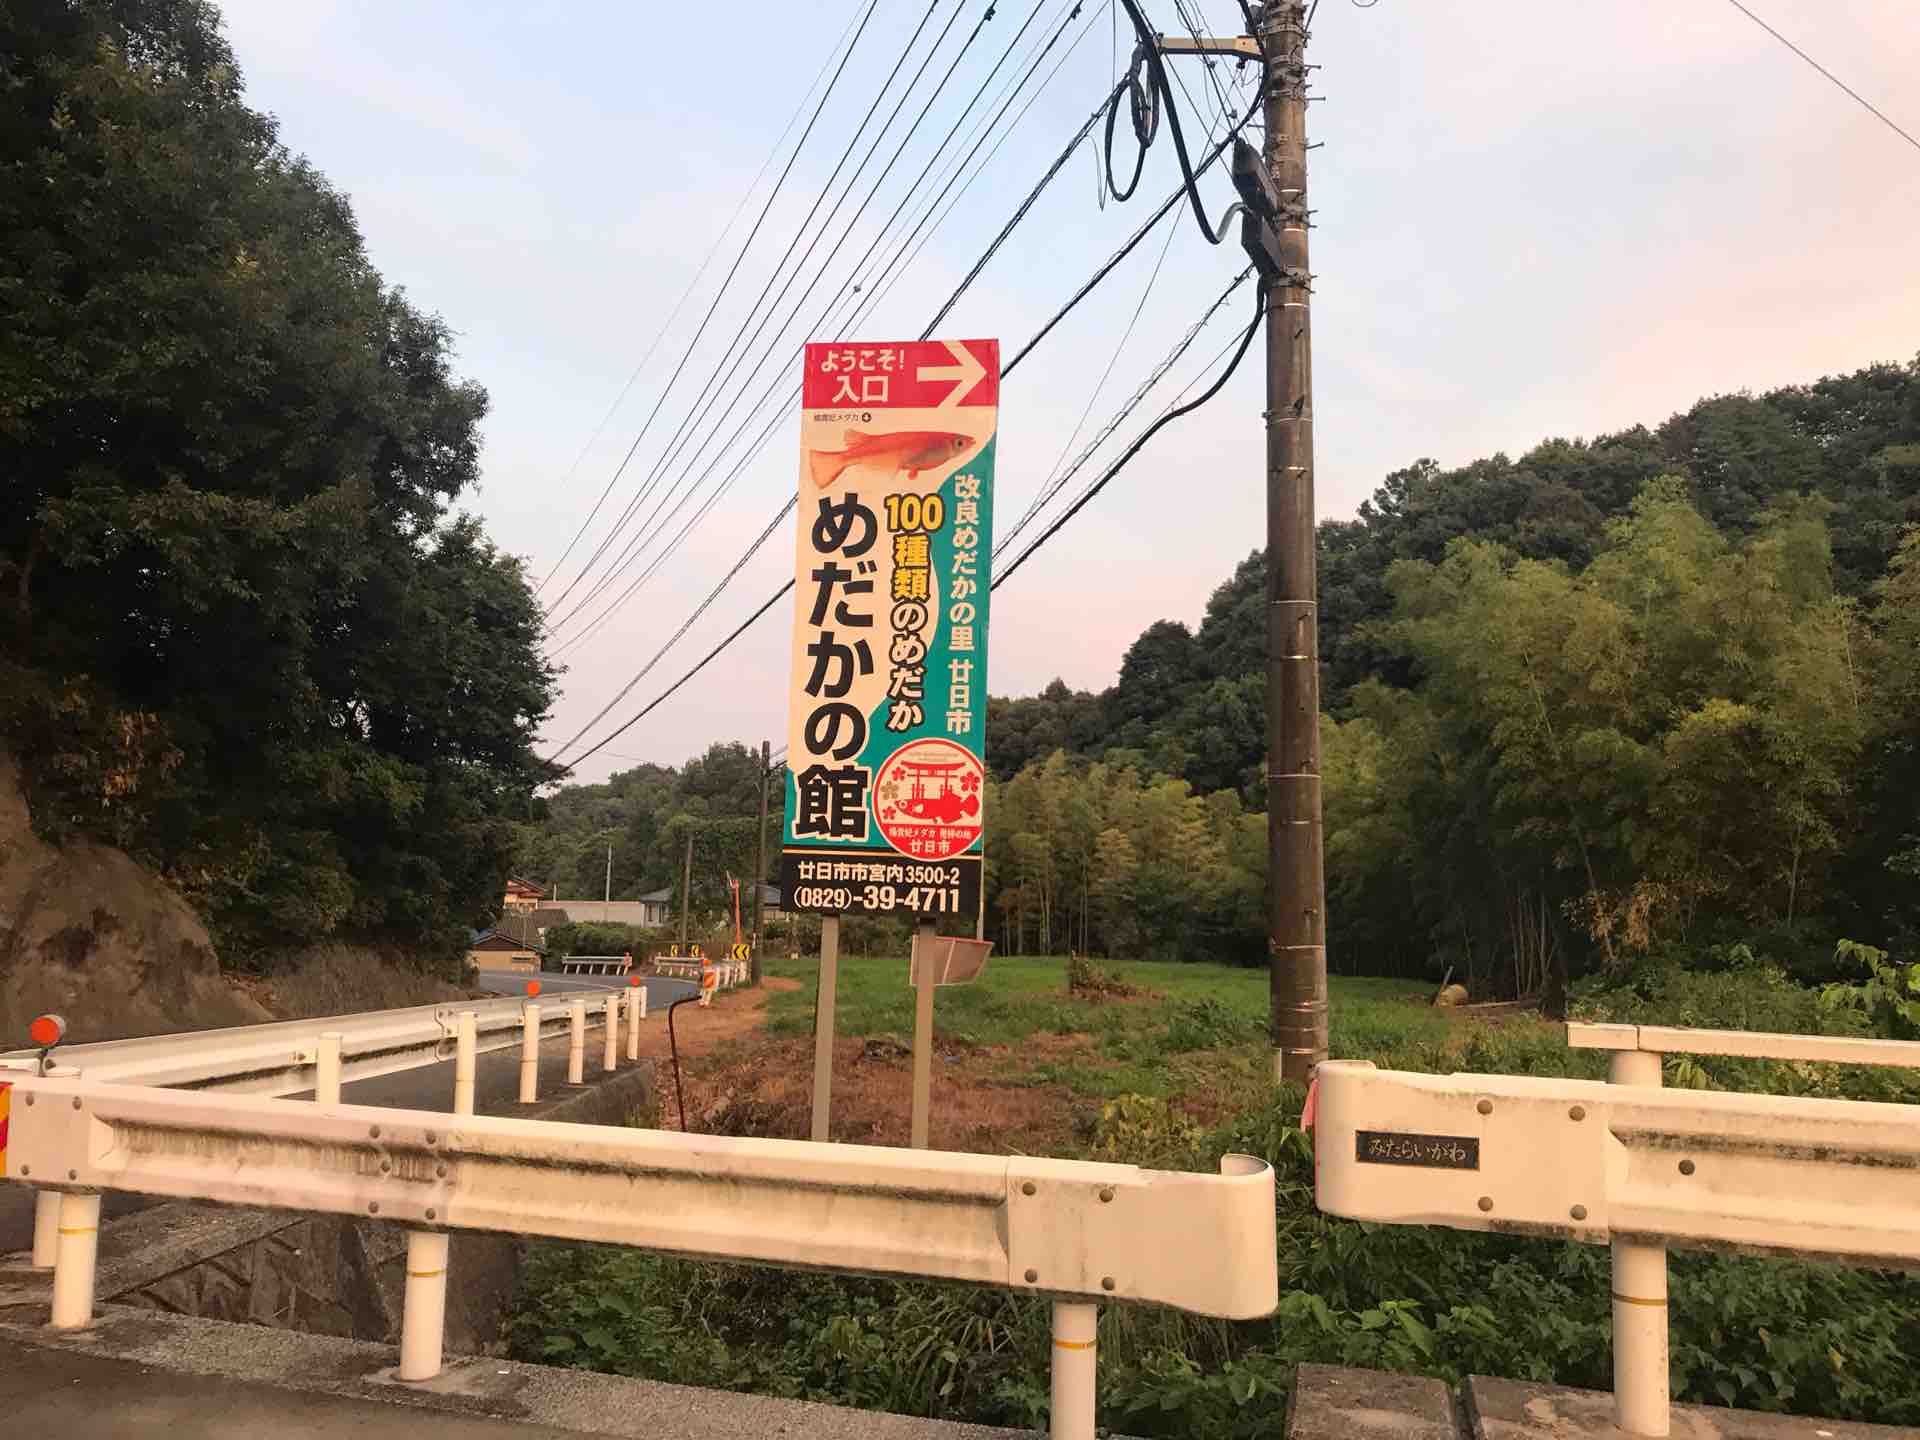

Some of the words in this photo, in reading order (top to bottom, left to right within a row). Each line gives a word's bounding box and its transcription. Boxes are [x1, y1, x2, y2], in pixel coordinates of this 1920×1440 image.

[820, 349, 905, 372] ようこそ!
[831, 375, 889, 403] 入口
[948, 474, 981, 651] 改良めだかの里
[793, 492, 878, 838] めだかの館
[945, 657, 974, 736] 廿日市
[908, 838, 952, 855] 廿日市
[793, 884, 960, 914] (0829)-39-4711
[1367, 1137, 1467, 1163] みたらいがわ
